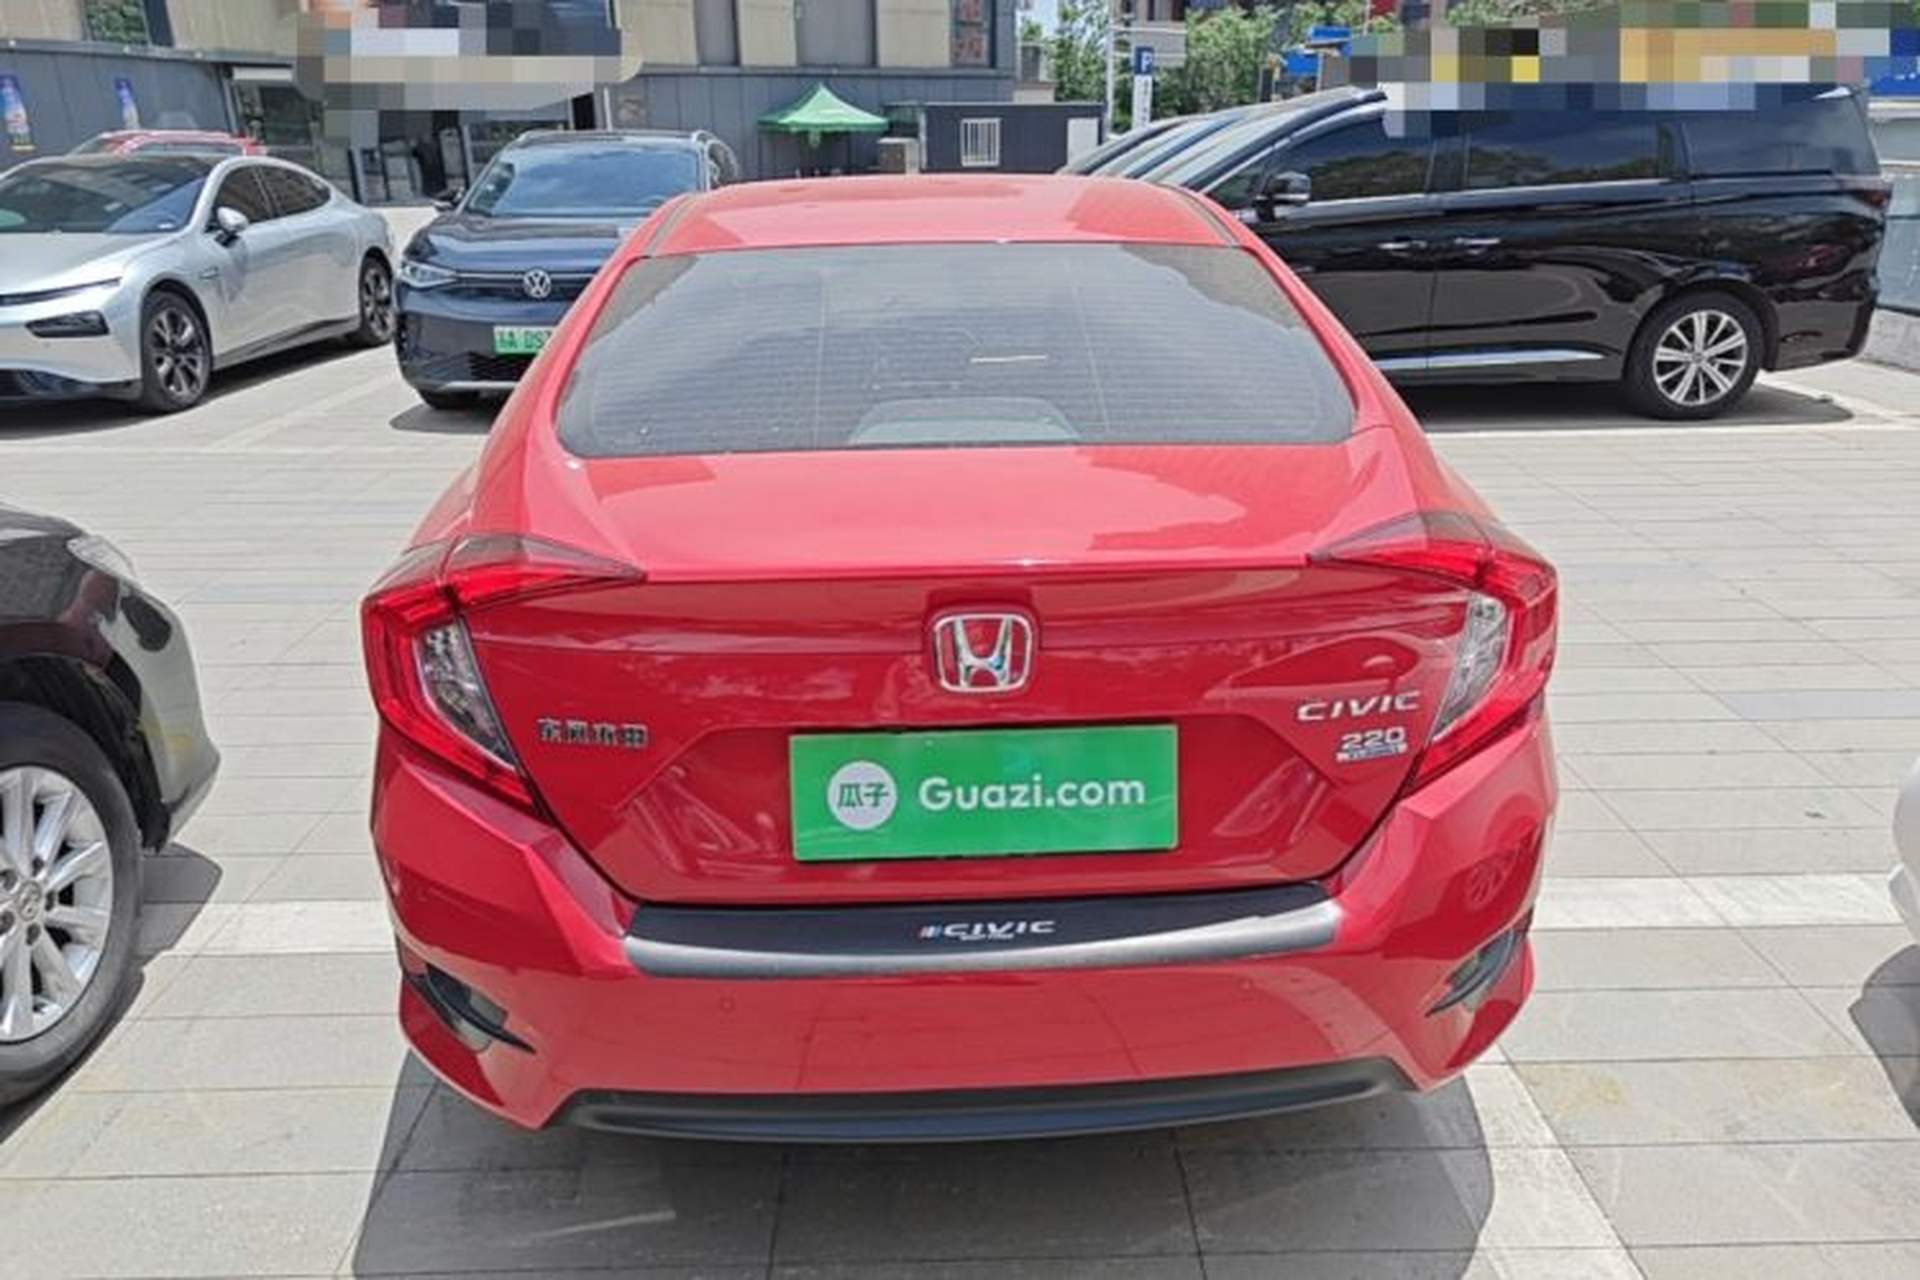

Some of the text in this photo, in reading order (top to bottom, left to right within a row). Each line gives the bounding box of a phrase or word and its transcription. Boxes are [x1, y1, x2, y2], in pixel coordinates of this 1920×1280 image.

[1141, 51, 1153, 73] P
[1298, 690, 1420, 720] CIVIC
[1341, 727, 1405, 750] 220
[837, 774, 1145, 810] 瓜子 Guazi.com
[943, 920, 1056, 937] CIVIC
